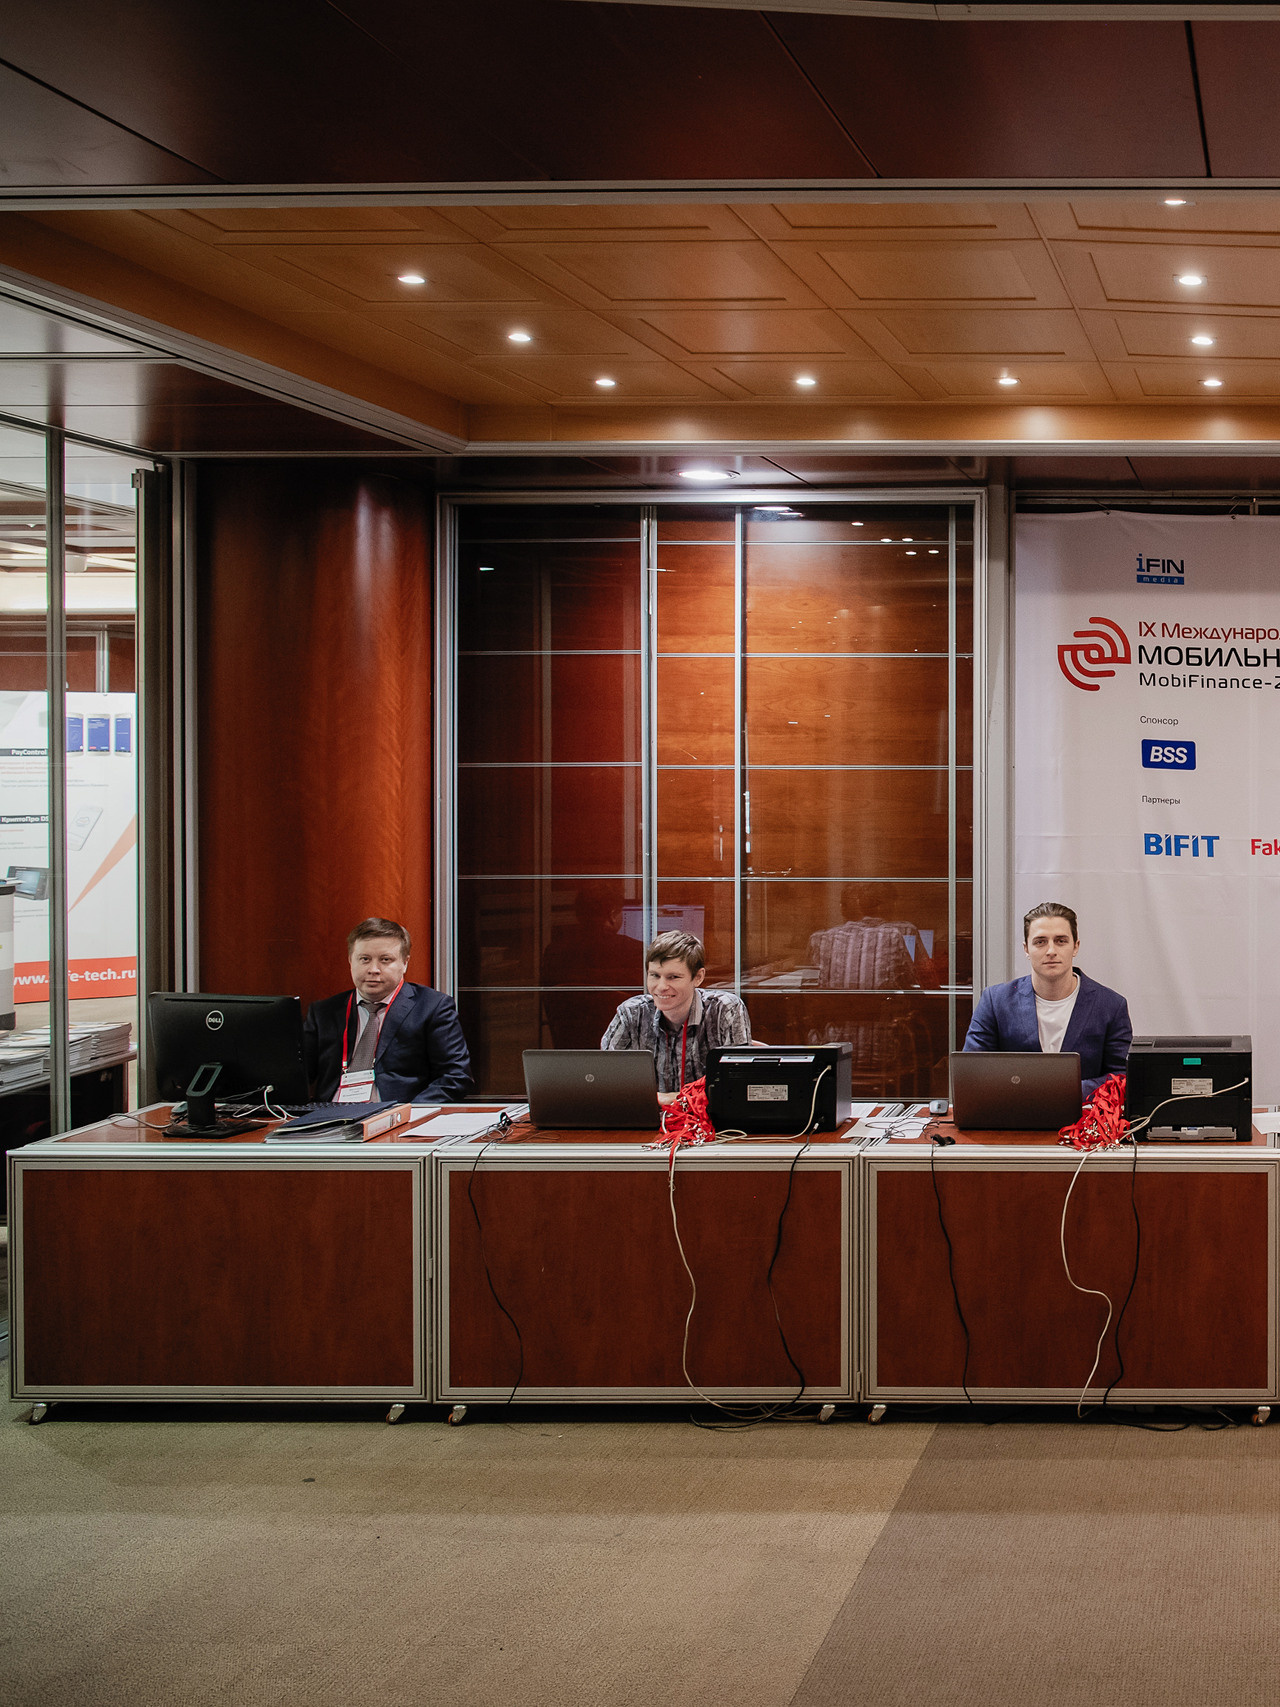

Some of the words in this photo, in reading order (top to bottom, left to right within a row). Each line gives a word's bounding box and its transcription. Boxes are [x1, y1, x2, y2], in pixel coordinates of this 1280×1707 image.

[1136, 553, 1185, 574] iFIN
[1142, 576, 1179, 584] media
[1138, 621, 1157, 638] IX
[1139, 715, 1179, 727] Спонсор
[11, 749, 47, 757] PayControl
[1149, 745, 1188, 764] BSS
[1141, 795, 1181, 806] Партнеры
